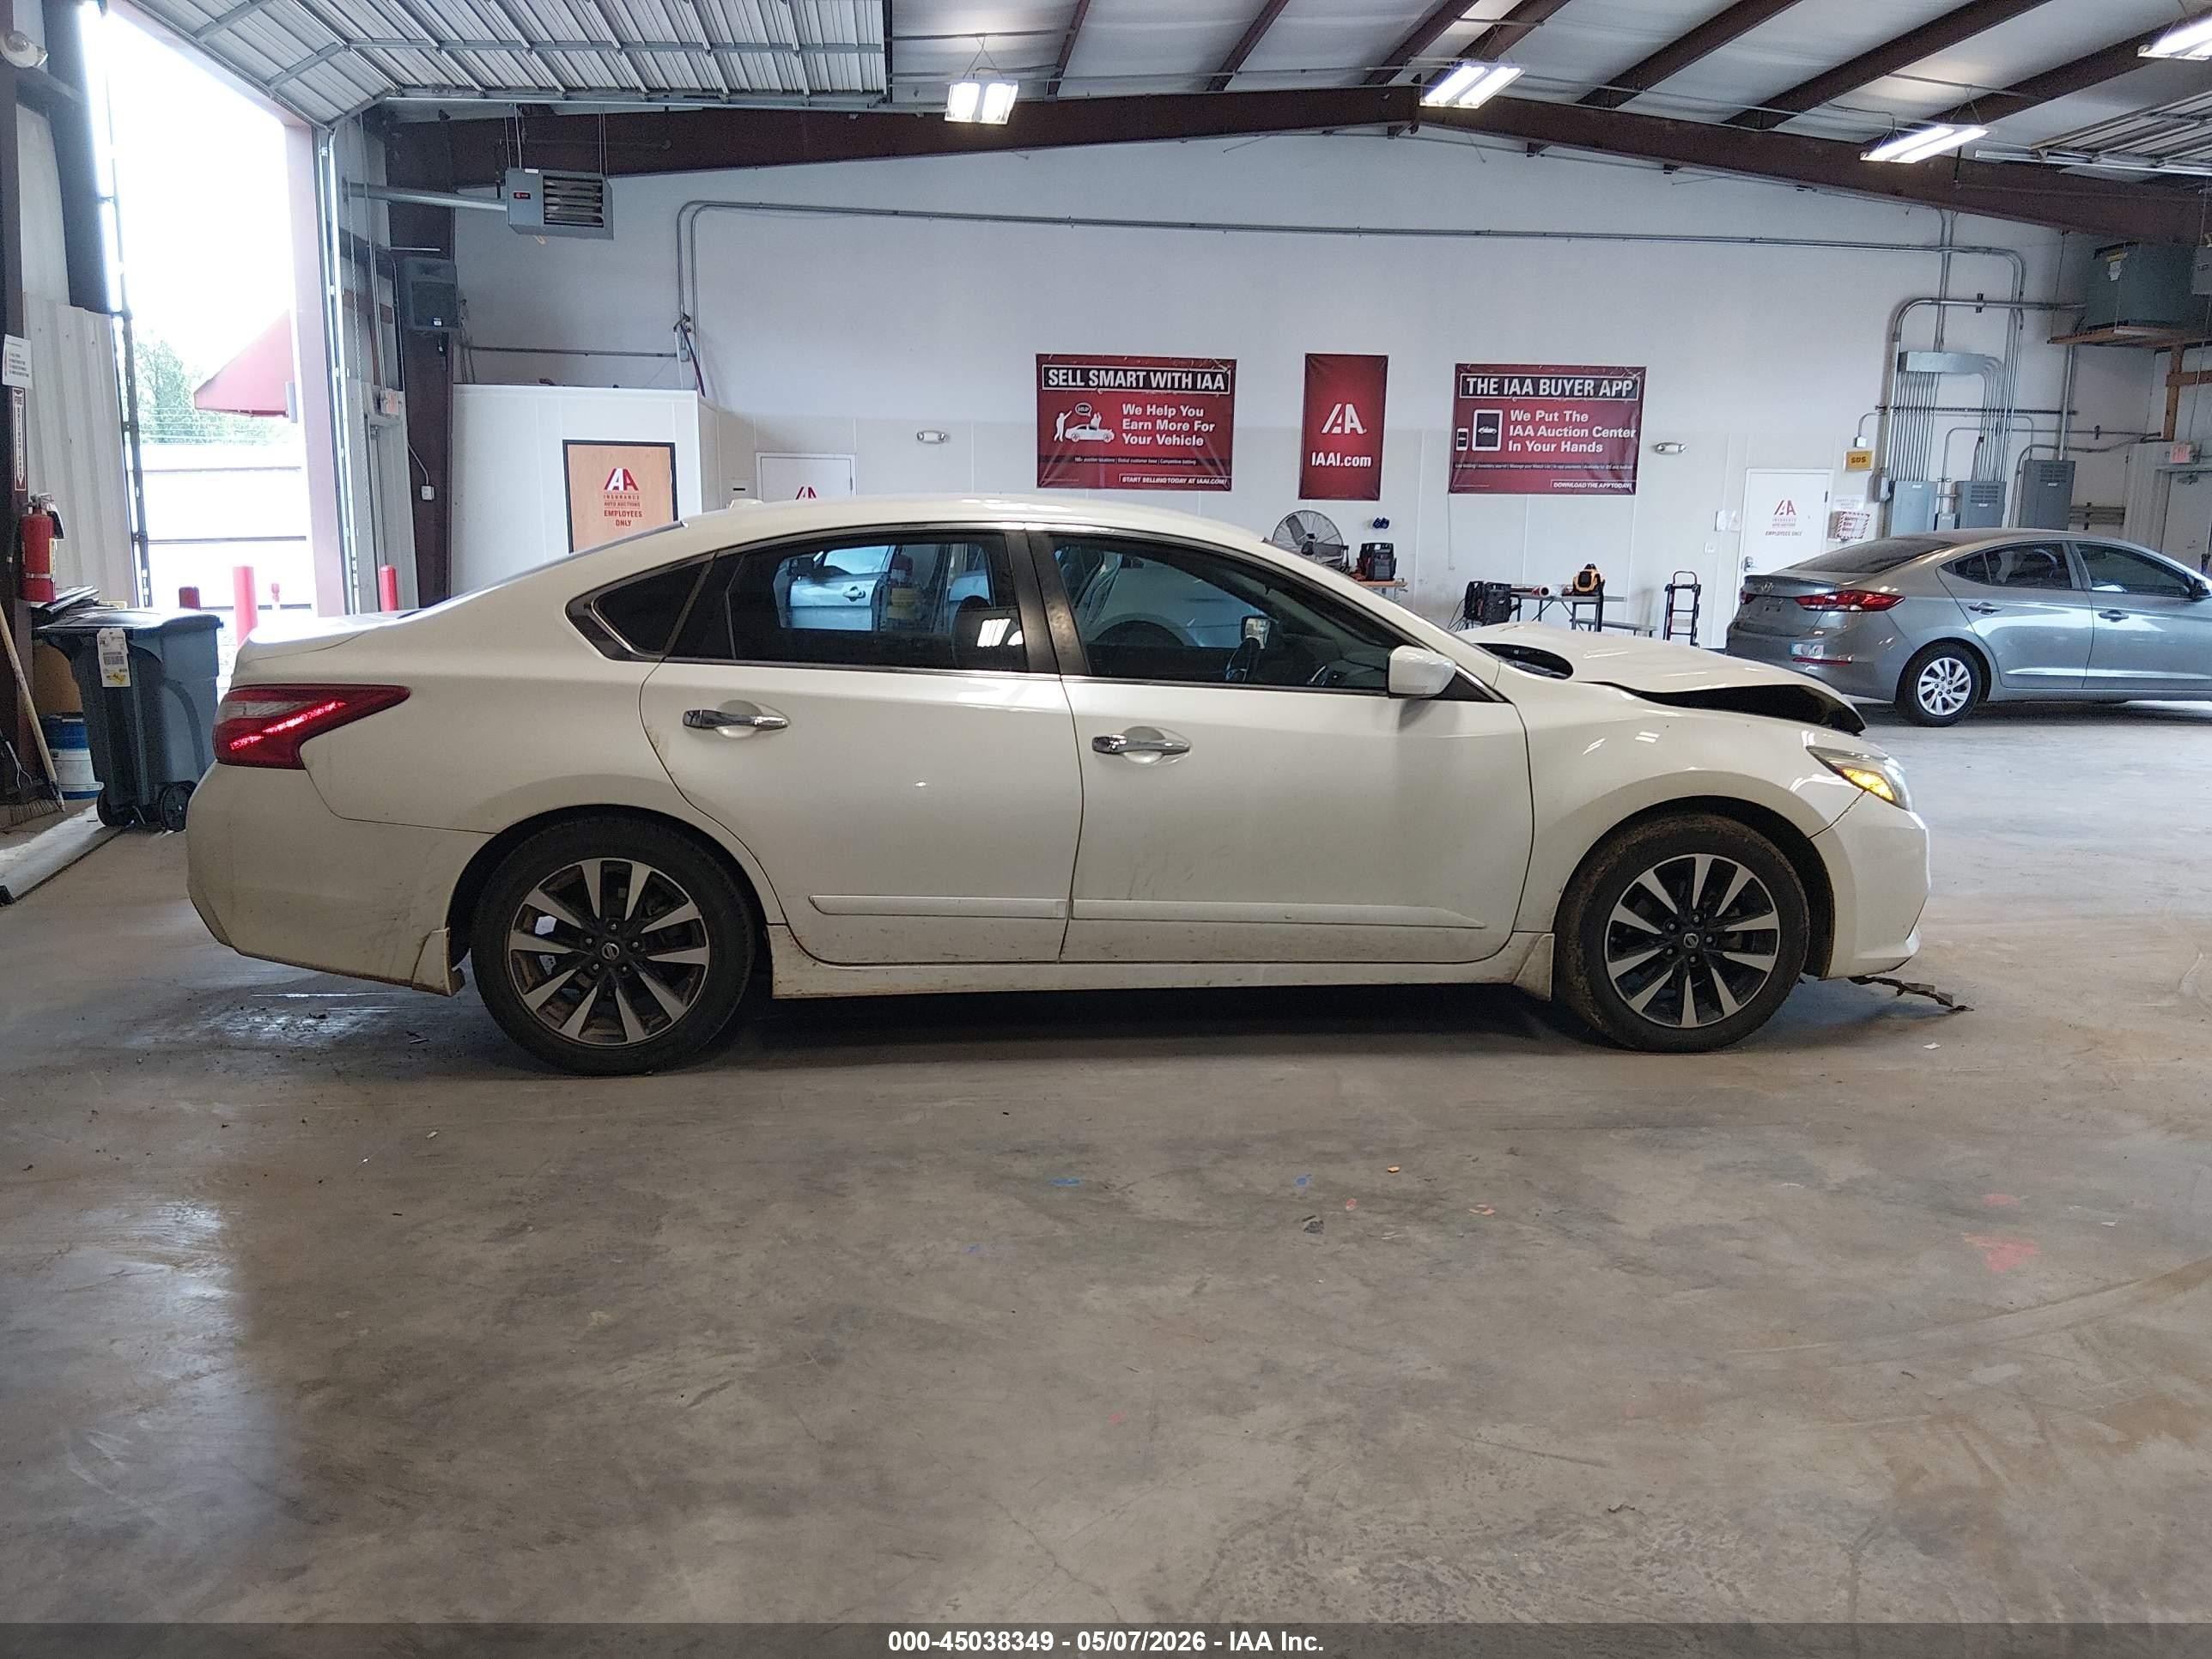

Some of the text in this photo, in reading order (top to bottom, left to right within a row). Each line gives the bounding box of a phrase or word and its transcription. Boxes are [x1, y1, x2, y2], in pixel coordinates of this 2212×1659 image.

[1048, 369, 1225, 391] SELL SMART WITH IAA
[1467, 377, 1633, 398] THE IAA BUYER APP
[1122, 404, 1204, 417] We Help You
[1510, 410, 1589, 422] We Put The
[1122, 418, 1216, 432] Earn More For
[1509, 425, 1637, 439] IAA Auction Center
[1122, 434, 1204, 447] Your Vehicle
[1508, 441, 1603, 453] In Your Hands
[1311, 452, 1372, 467] IAAI.com
[604, 509, 643, 518] EMPLOYEES
[616, 519, 632, 527] ONLY
